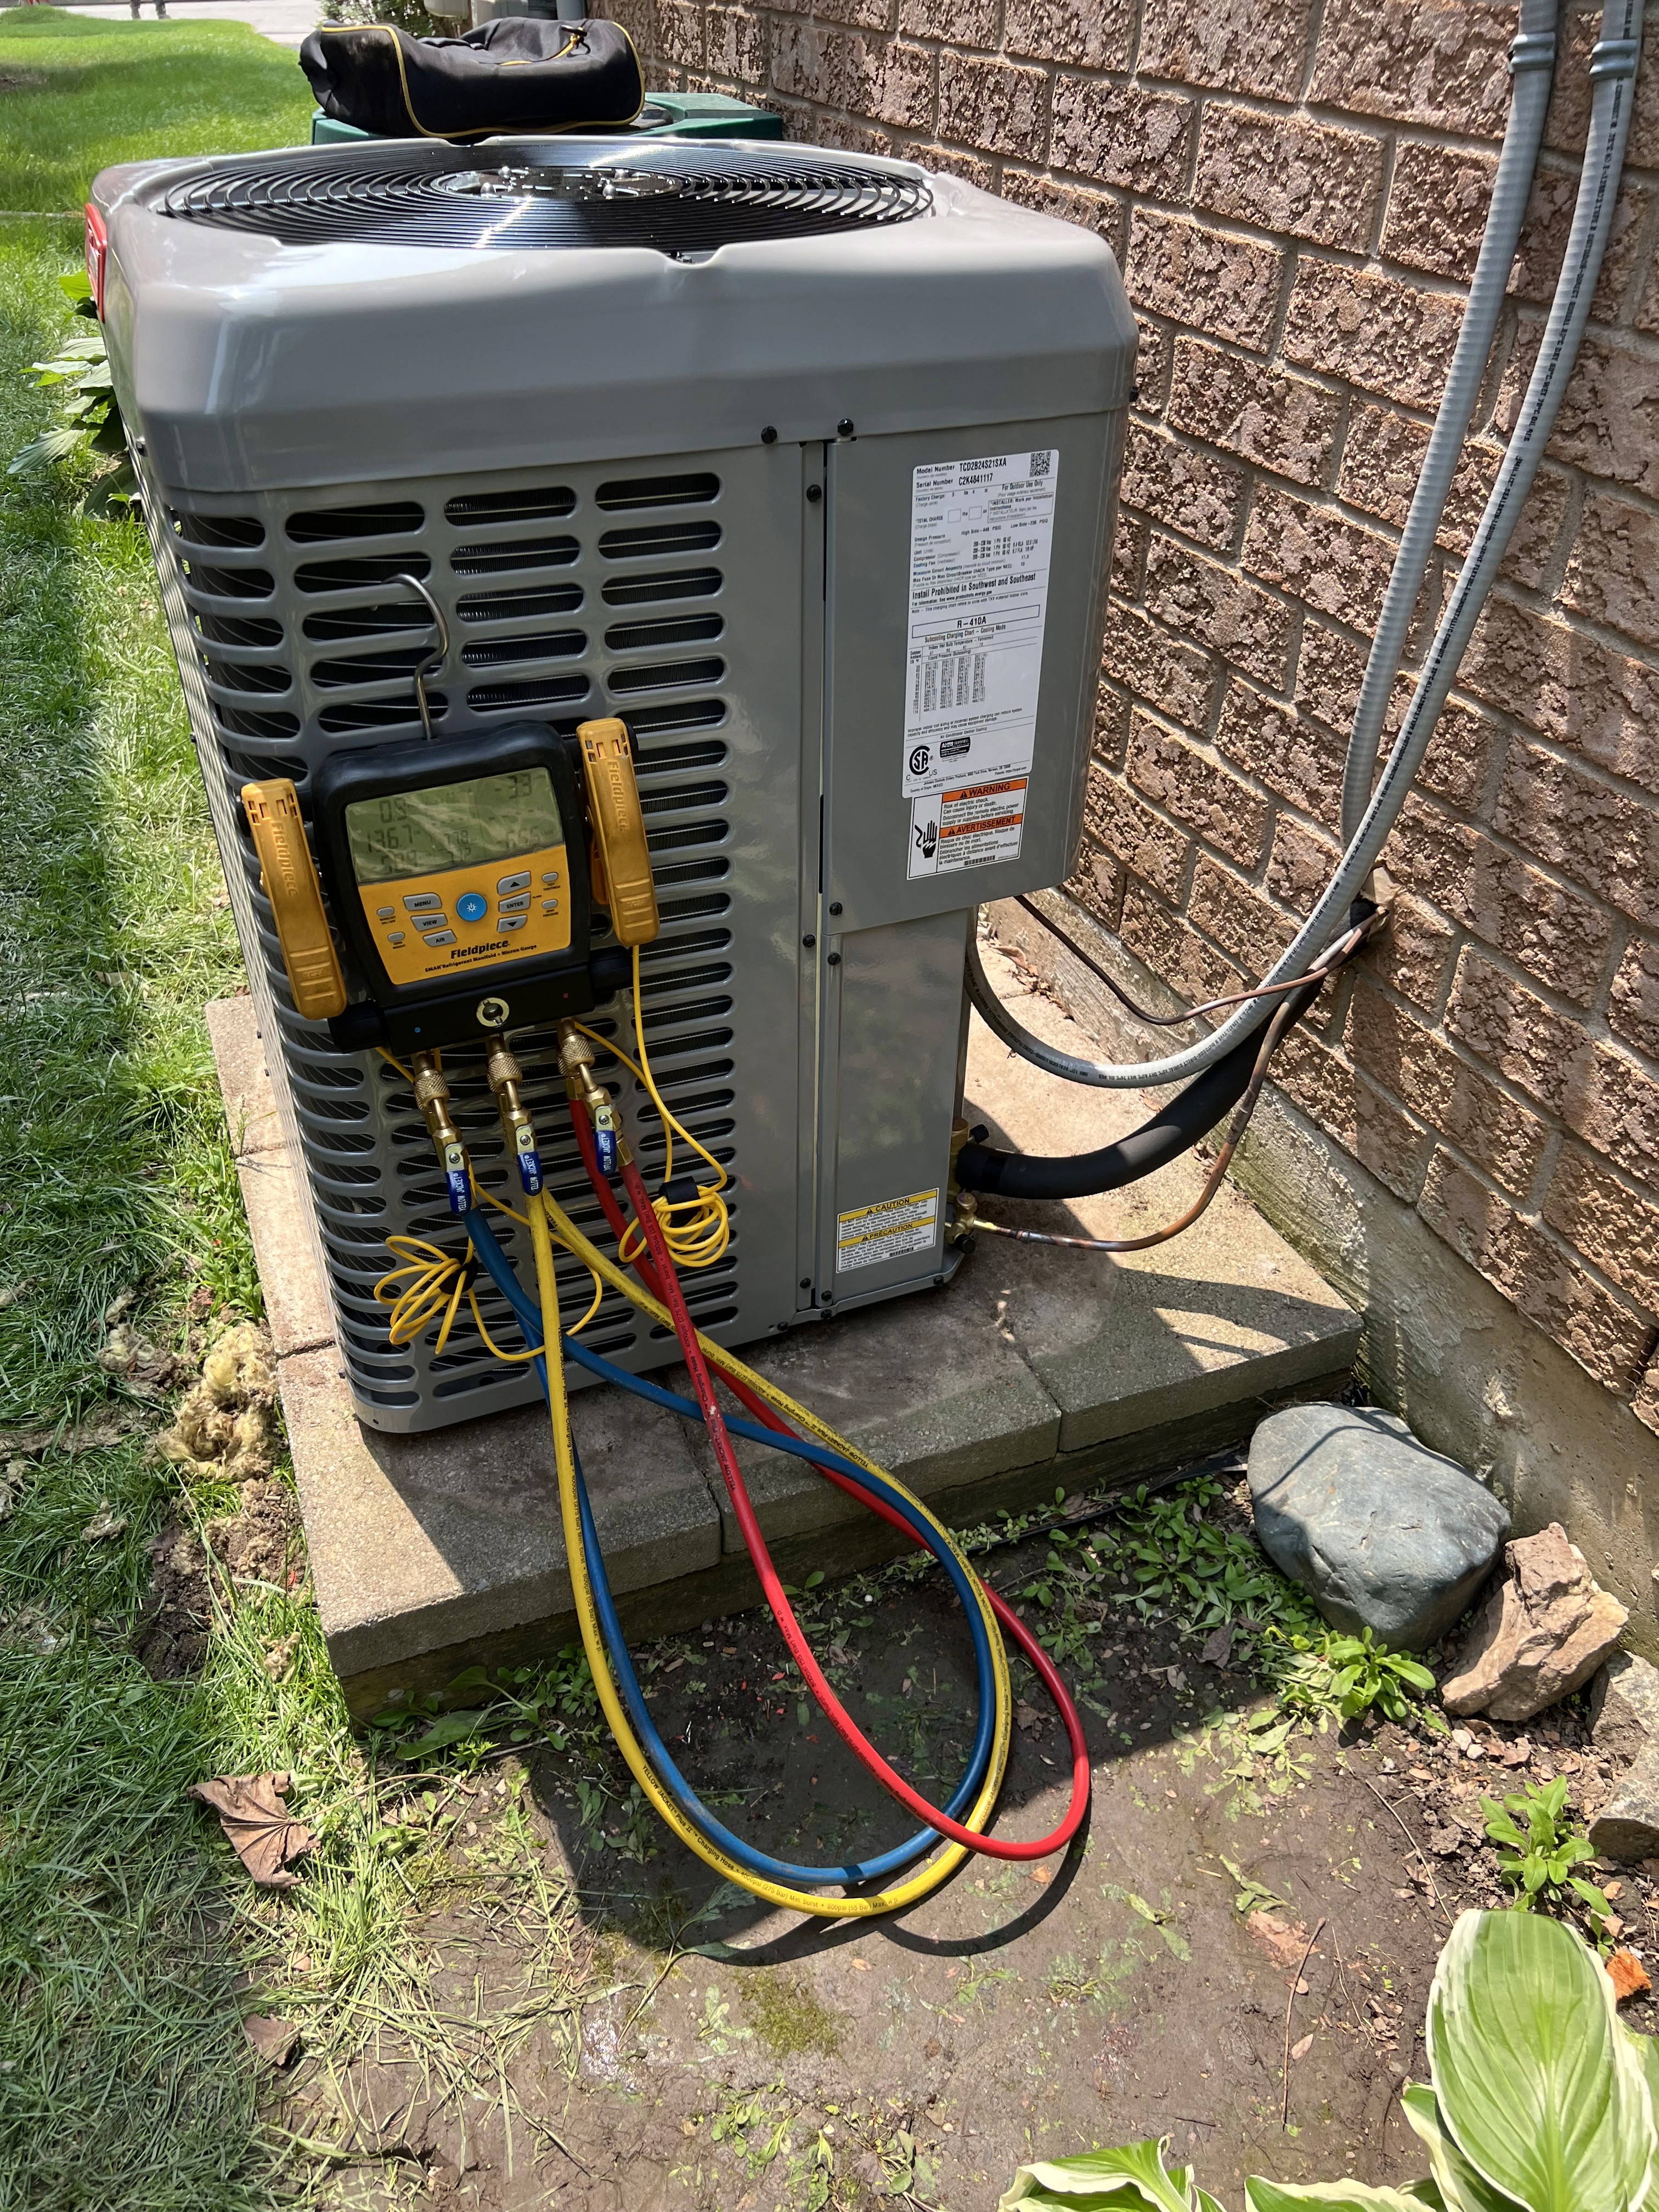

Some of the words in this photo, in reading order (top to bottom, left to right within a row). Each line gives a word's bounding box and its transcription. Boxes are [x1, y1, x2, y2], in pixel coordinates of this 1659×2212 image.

[912, 589, 930, 600] Install
[931, 584, 960, 597] Prohibited
[961, 584, 967, 592] in
[968, 578, 997, 591] Southwest
[998, 577, 1008, 586] and
[1009, 573, 1036, 585] Southeast
[946, 631, 963, 640] Charging
[929, 769, 938, 777] US
[606, 759, 630, 832] Fieldpiece
[968, 782, 1011, 797] WARNING
[943, 812, 967, 822] Disconnect
[956, 816, 1016, 834] AVERTISSEMENT
[963, 815, 980, 823] supplies
[271, 821, 298, 897] Fieldpiece
[450, 939, 509, 960] Fieldpiece
[442, 958, 473, 969] Refrigerant
[473, 952, 496, 962] Manifold
[603, 1154, 613, 1171] YELLOW
[458, 1191, 467, 1213] YELLOW
[875, 1198, 910, 1212] CAUTION
[870, 1223, 913, 1239] PRÉCAUTION
[702, 1346, 715, 1358] burst
[691, 1355, 699, 1372] Hose
[696, 1372, 709, 1403] Charging
[770, 1395, 784, 1407] Hose
[783, 1403, 805, 1423] Charging
[816, 1428, 827, 1438] Plus
[850, 1451, 869, 1469] YELLOW
[723, 1464, 735, 1492] YELLOW
[642, 1764, 659, 1790] YELLOW
[675, 1813, 687, 1827] Plus
[685, 1824, 694, 1834] II
[697, 1837, 720, 1860] Charging
[720, 1856, 734, 1871] Hose
[741, 1871, 762, 1887] 4000psi
[761, 1882, 775, 1894] (275
[775, 1888, 788, 1900] Bar)
[802, 1899, 819, 1908] burst
[826, 1903, 847, 1913] 800psi
[848, 1903, 859, 1913] (55
